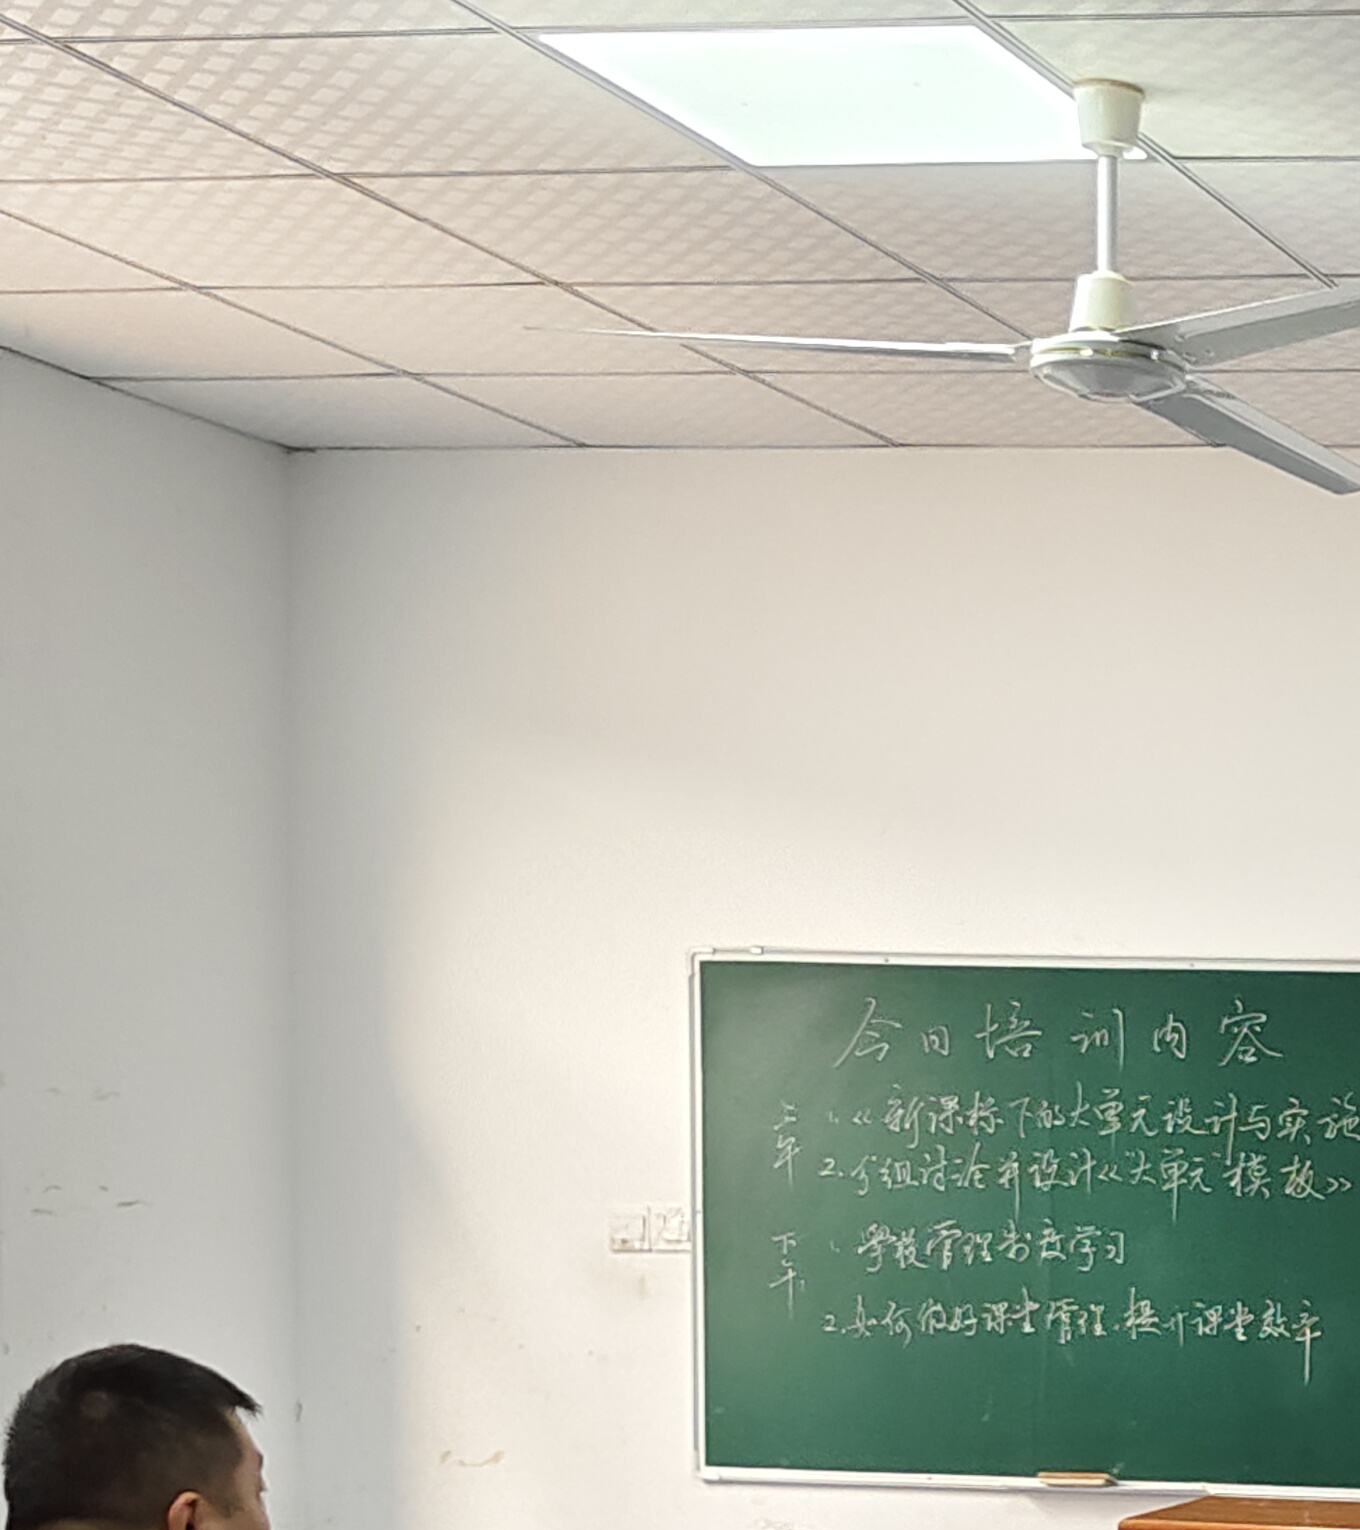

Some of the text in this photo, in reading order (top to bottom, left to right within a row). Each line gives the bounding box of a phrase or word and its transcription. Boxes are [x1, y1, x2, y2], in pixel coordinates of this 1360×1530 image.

[833, 997, 1284, 1072] 今日培训内容
